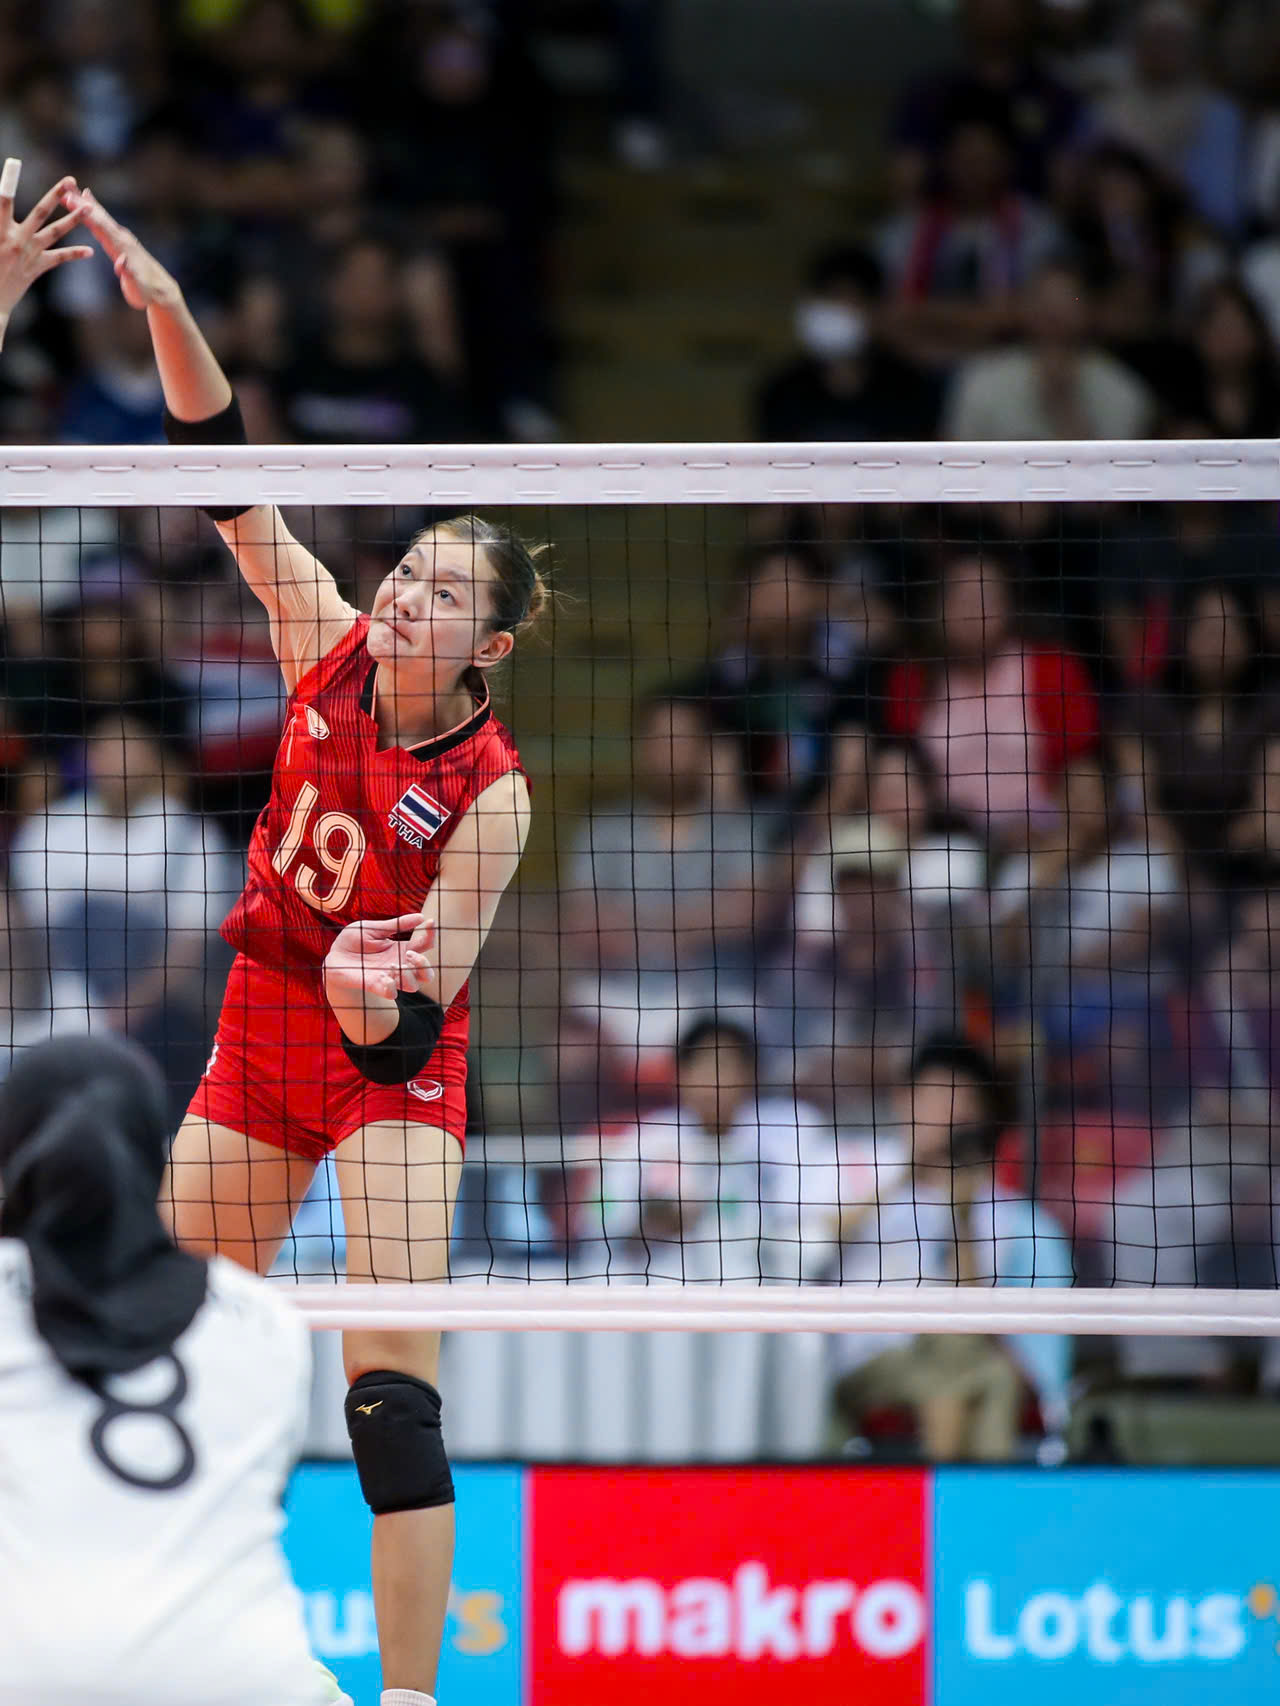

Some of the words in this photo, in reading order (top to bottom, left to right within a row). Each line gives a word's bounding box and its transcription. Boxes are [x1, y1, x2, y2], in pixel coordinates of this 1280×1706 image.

[271, 780, 366, 913] 19
[388, 813, 424, 849] THA
[91, 1350, 195, 1492] 8
[558, 1561, 924, 1661] makro
